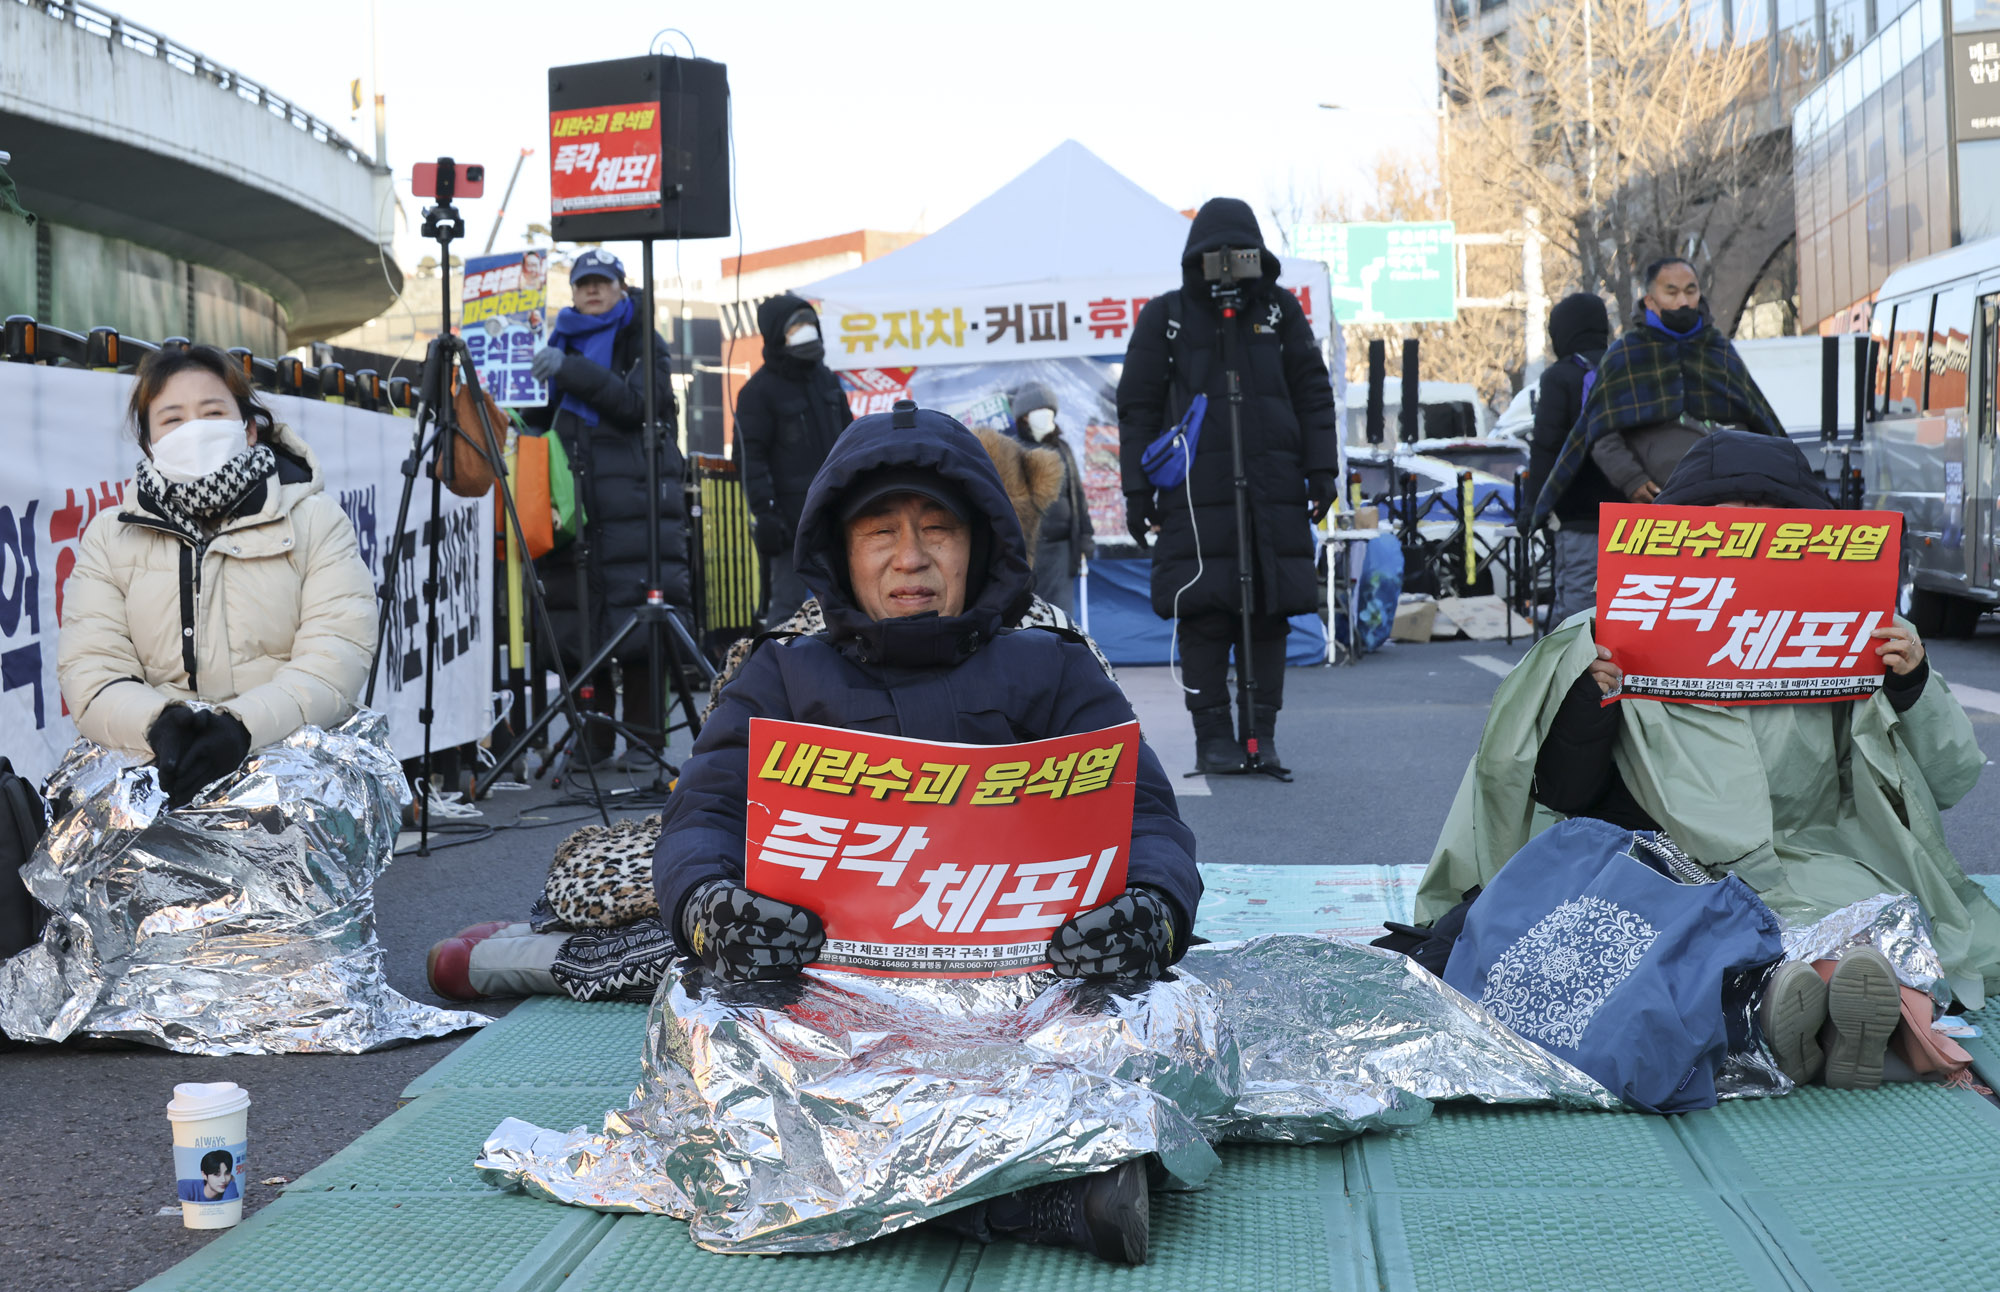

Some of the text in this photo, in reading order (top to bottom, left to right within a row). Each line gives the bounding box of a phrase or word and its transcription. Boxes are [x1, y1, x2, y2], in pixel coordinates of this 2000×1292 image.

[552, 109, 656, 137] 내란수괴 윤석열
[554, 142, 657, 192] 즉각 체포!
[467, 331, 535, 366] 윤석열
[1606, 518, 1890, 560] 내란수괴 윤석열
[1606, 574, 1884, 670] 즉각 체포!
[1630, 676, 1658, 686] 윤석열
[1661, 679, 1679, 689] 즉각
[1681, 680, 1703, 689] 체포!
[1706, 681, 1733, 690] 김건희
[1736, 681, 1753, 690] 즉각
[1756, 681, 1778, 689] 구속!
[1791, 679, 1818, 688] 때까지
[1820, 678, 1850, 687] 모이자!
[757, 740, 1125, 806] 내란수괴 윤석열
[758, 809, 1119, 933] 즉각 체포!
[832, 941, 857, 955] 즉각
[860, 943, 888, 956] 체포!
[892, 945, 929, 958] 김건희
[931, 947, 956, 959] 즉각
[959, 946, 988, 959] 구속!
[1006, 942, 1042, 957] 때까지
[848, 957, 910, 968] 100-036-164860
[911, 960, 942, 970] 촛불행동
[949, 961, 965, 969] ARS
[966, 959, 1018, 969] 060-707-3300
